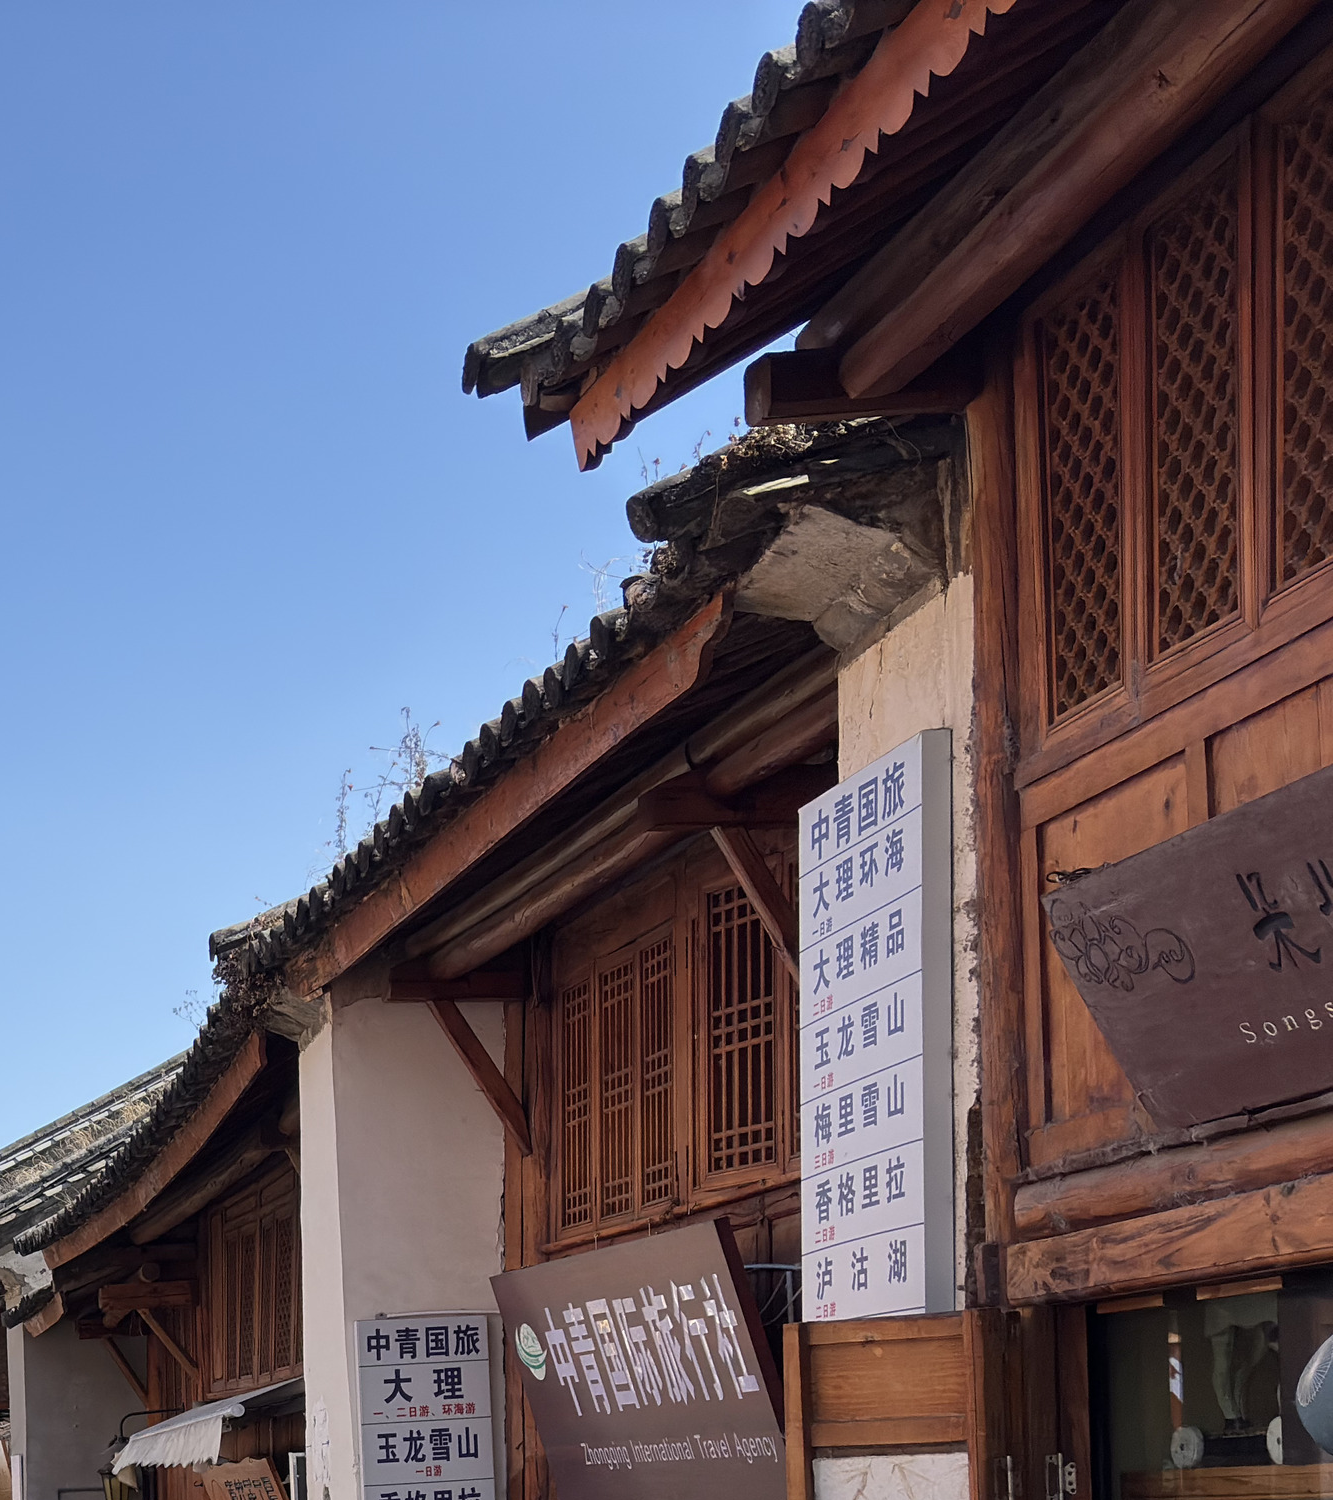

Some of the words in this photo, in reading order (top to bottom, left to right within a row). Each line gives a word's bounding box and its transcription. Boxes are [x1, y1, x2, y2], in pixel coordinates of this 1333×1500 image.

[810, 761, 905, 861] 中青国旅
[812, 828, 904, 919] 大理环海
[811, 917, 834, 937] 一日游
[813, 909, 905, 995] 大理精品
[812, 994, 834, 1016] 二日游
[814, 992, 905, 1073] 玉龙雪山
[813, 1072, 835, 1091] 一日游
[814, 1075, 905, 1147] 梅里雪山
[813, 1149, 835, 1170] 三日游
[814, 1156, 906, 1225] 香格里拉
[814, 1225, 836, 1244] 二日游
[816, 1240, 908, 1300] 泸沽湖
[815, 1301, 837, 1319] 二日游
[367, 1324, 480, 1361] 中青国旅
[545, 1273, 760, 1417] 中青国际旅行社
[384, 1367, 464, 1403] 大理
[373, 1403, 476, 1419] 一、二日游、环海游
[377, 1427, 479, 1464] 玉龙雪山
[633, 1436, 694, 1465] International
[695, 1432, 733, 1460] Travel
[734, 1431, 779, 1464] Agency
[415, 1465, 442, 1478] 一日游
